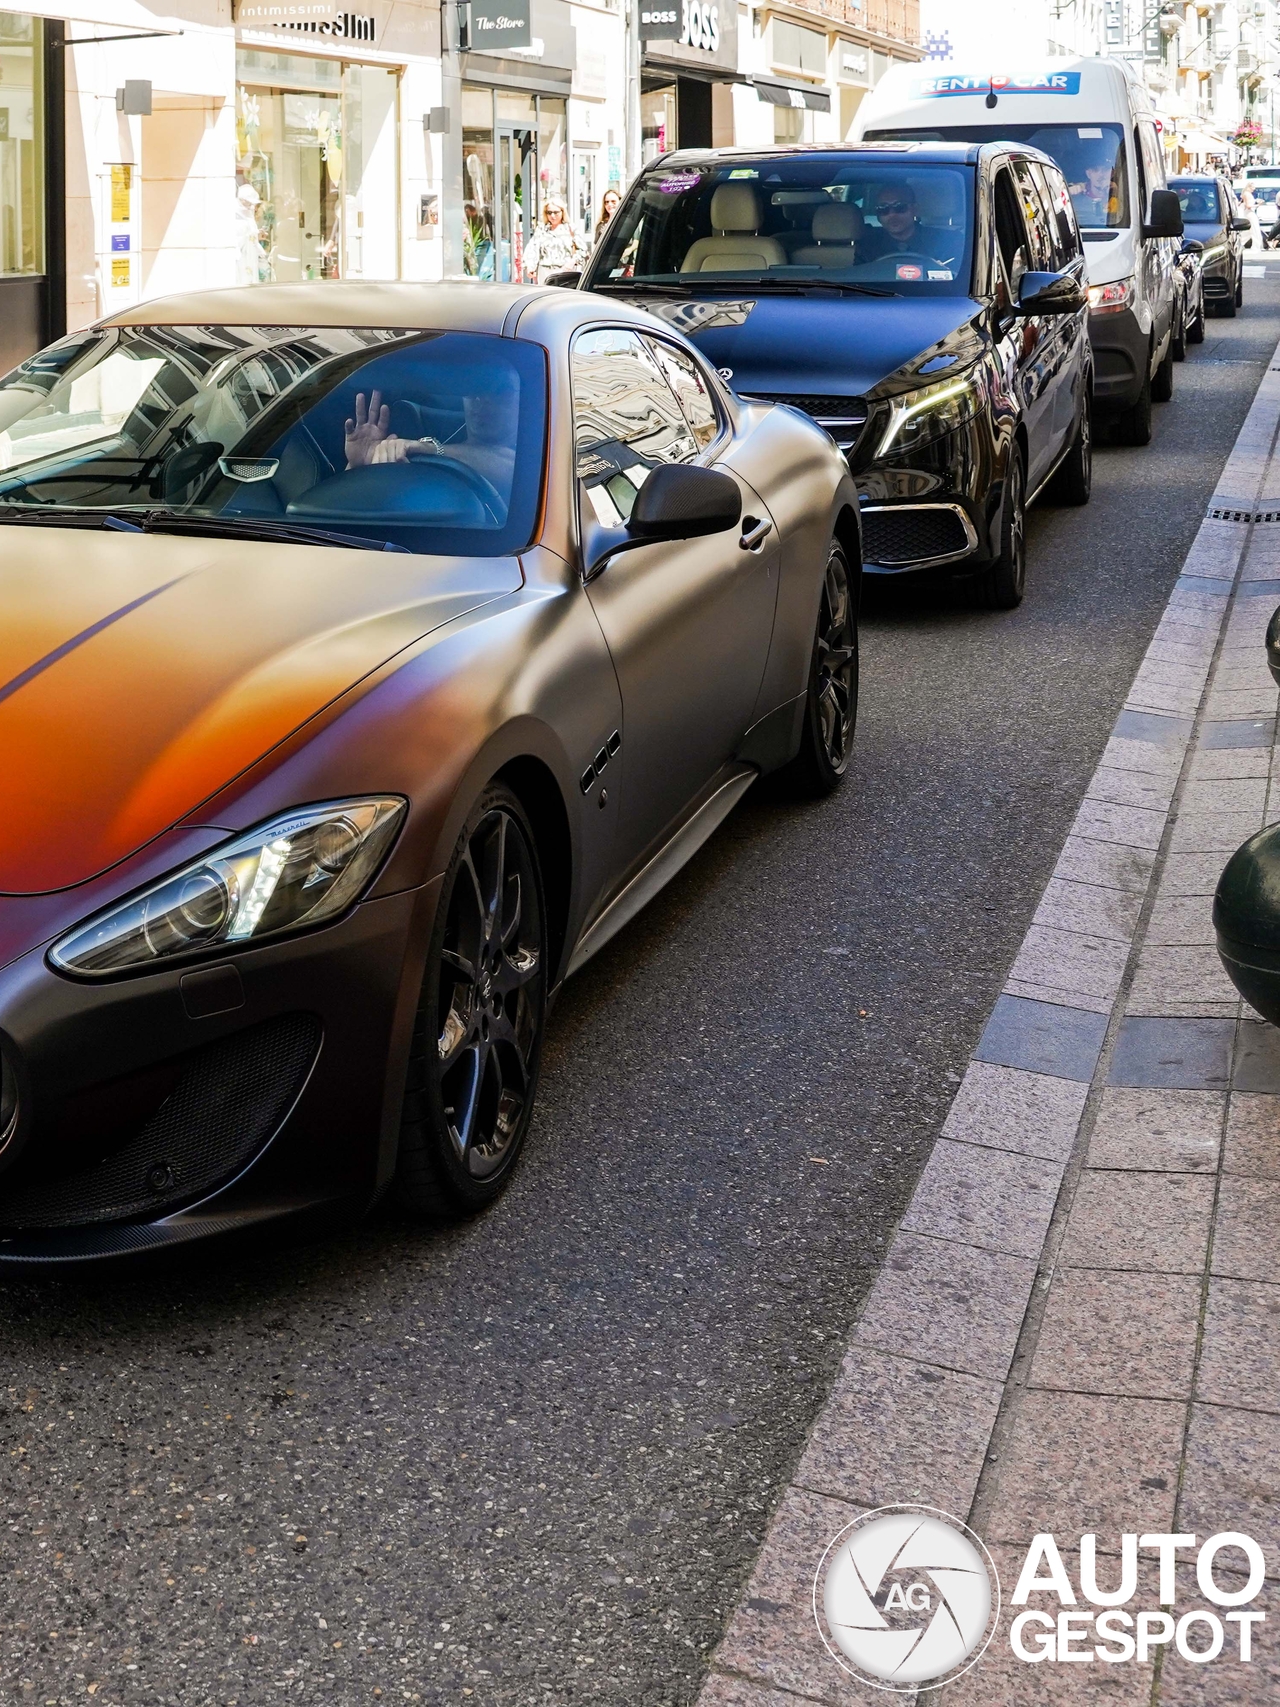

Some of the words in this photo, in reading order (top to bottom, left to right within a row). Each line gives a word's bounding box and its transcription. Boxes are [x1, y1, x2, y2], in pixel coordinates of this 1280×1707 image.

[242, 4, 332, 17] intimissimi
[642, 11, 677, 24] BOSS
[476, 17, 495, 30] The
[496, 15, 526, 30] Store
[921, 78, 981, 92] RENT
[1014, 75, 1068, 88] CAR
